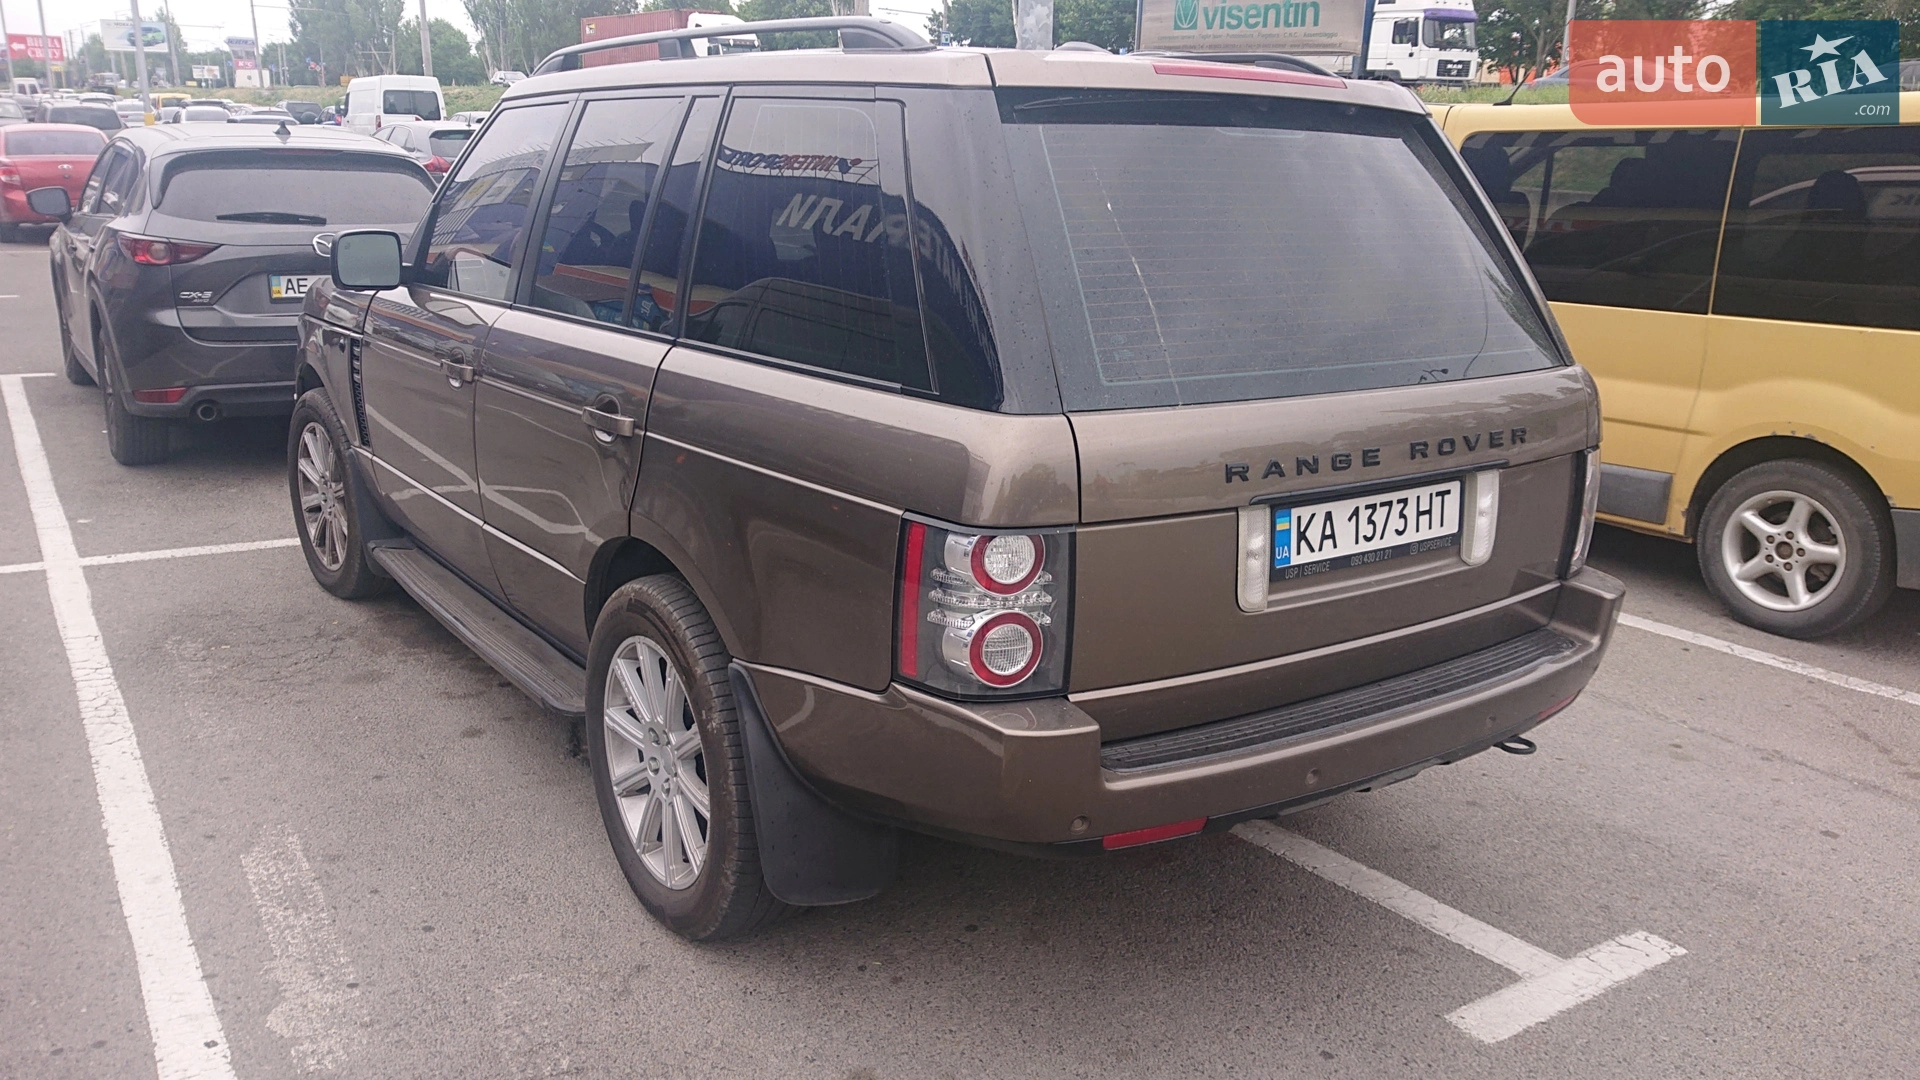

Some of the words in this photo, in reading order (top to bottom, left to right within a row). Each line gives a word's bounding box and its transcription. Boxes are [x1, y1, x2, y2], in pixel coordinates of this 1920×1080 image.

[1202, 0, 1320, 30] visentin
[285, 278, 308, 294] AE
[179, 291, 213, 299] CX-5
[1225, 448, 1381, 483] RANGE
[1410, 426, 1527, 460] ROVER
[1296, 510, 1338, 556] KA
[1347, 497, 1409, 546] 1373
[1415, 489, 1451, 533] HT
[1419, 536, 1453, 552] USPSERVICE
[1275, 546, 1290, 560] UA
[1351, 554, 1363, 567] 093
[1363, 552, 1376, 564] 430
[1285, 568, 1298, 579] USP
[1304, 560, 1331, 576] SERVICE
